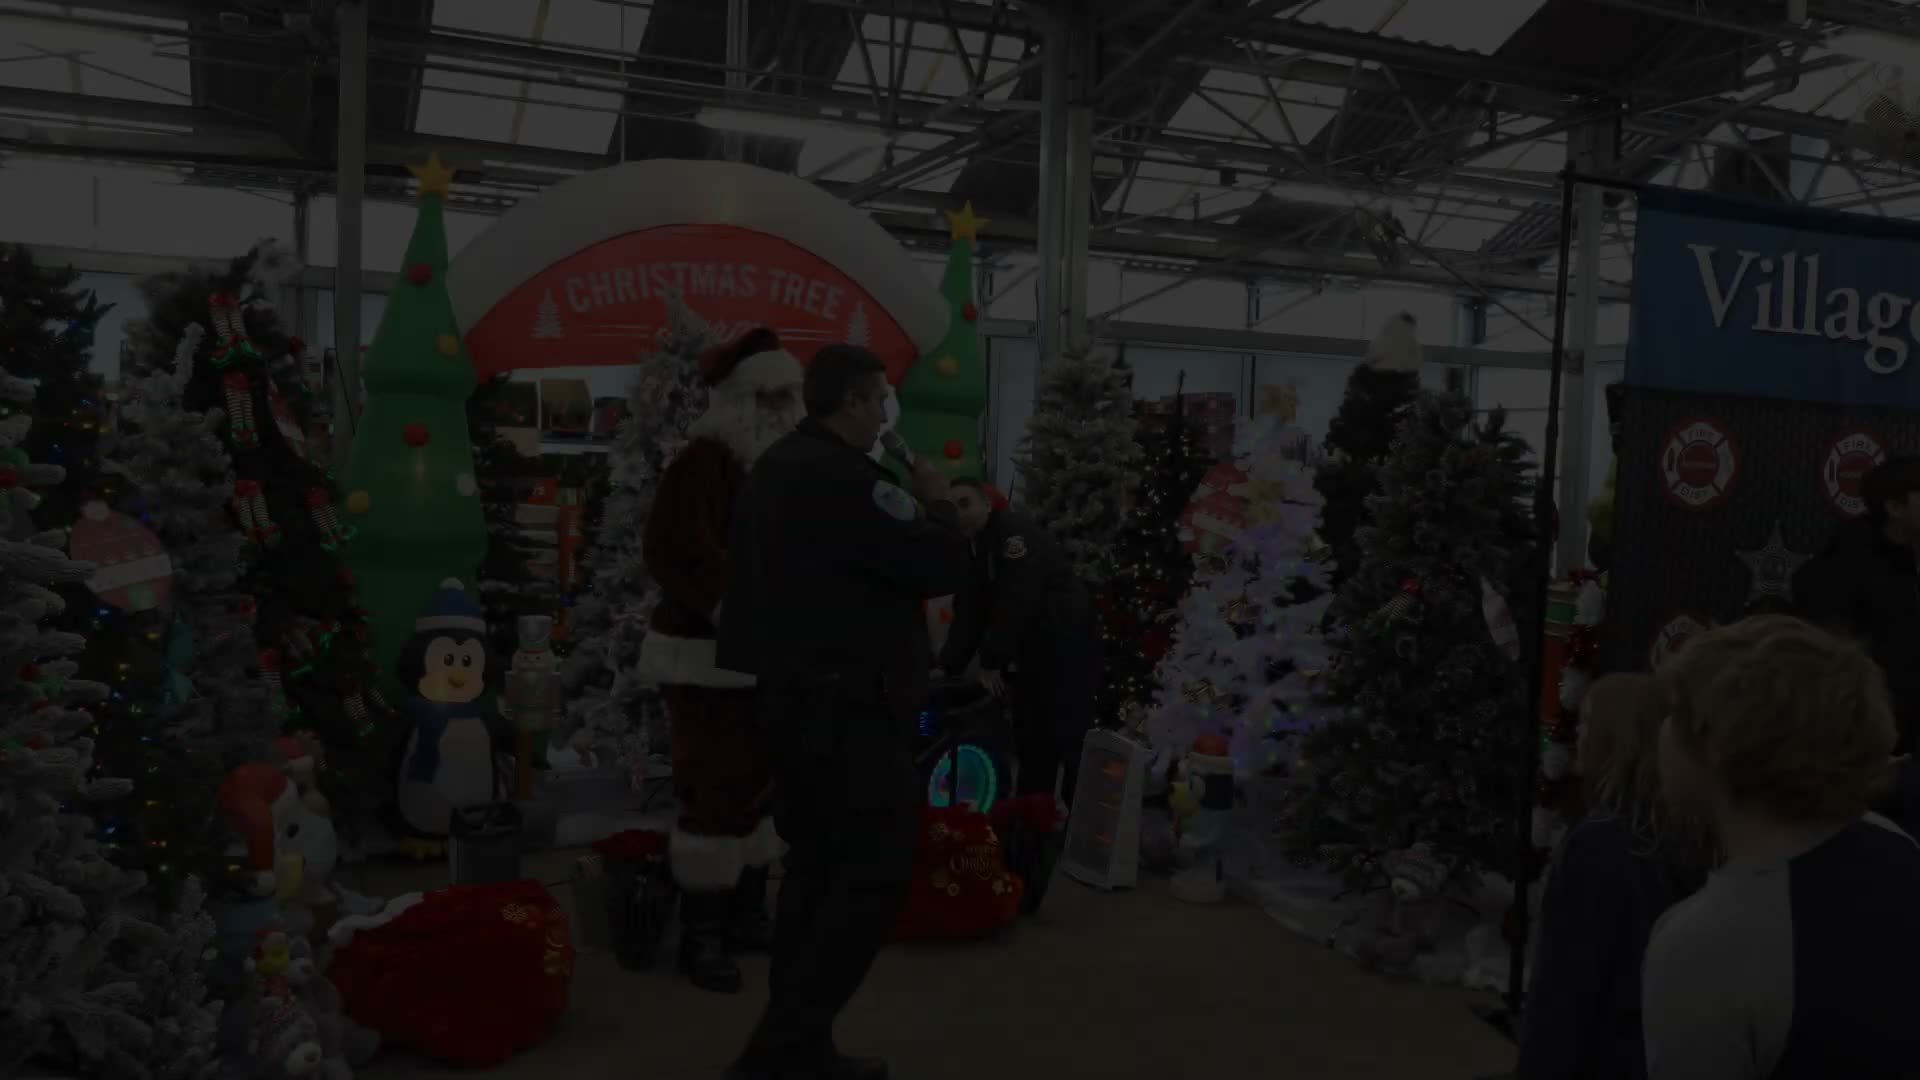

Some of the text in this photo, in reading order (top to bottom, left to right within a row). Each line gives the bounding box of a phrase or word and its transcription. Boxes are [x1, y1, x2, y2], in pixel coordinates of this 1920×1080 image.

[565, 261, 847, 320] CHRISTMAS TREE
[1687, 243, 1920, 375] Villag
